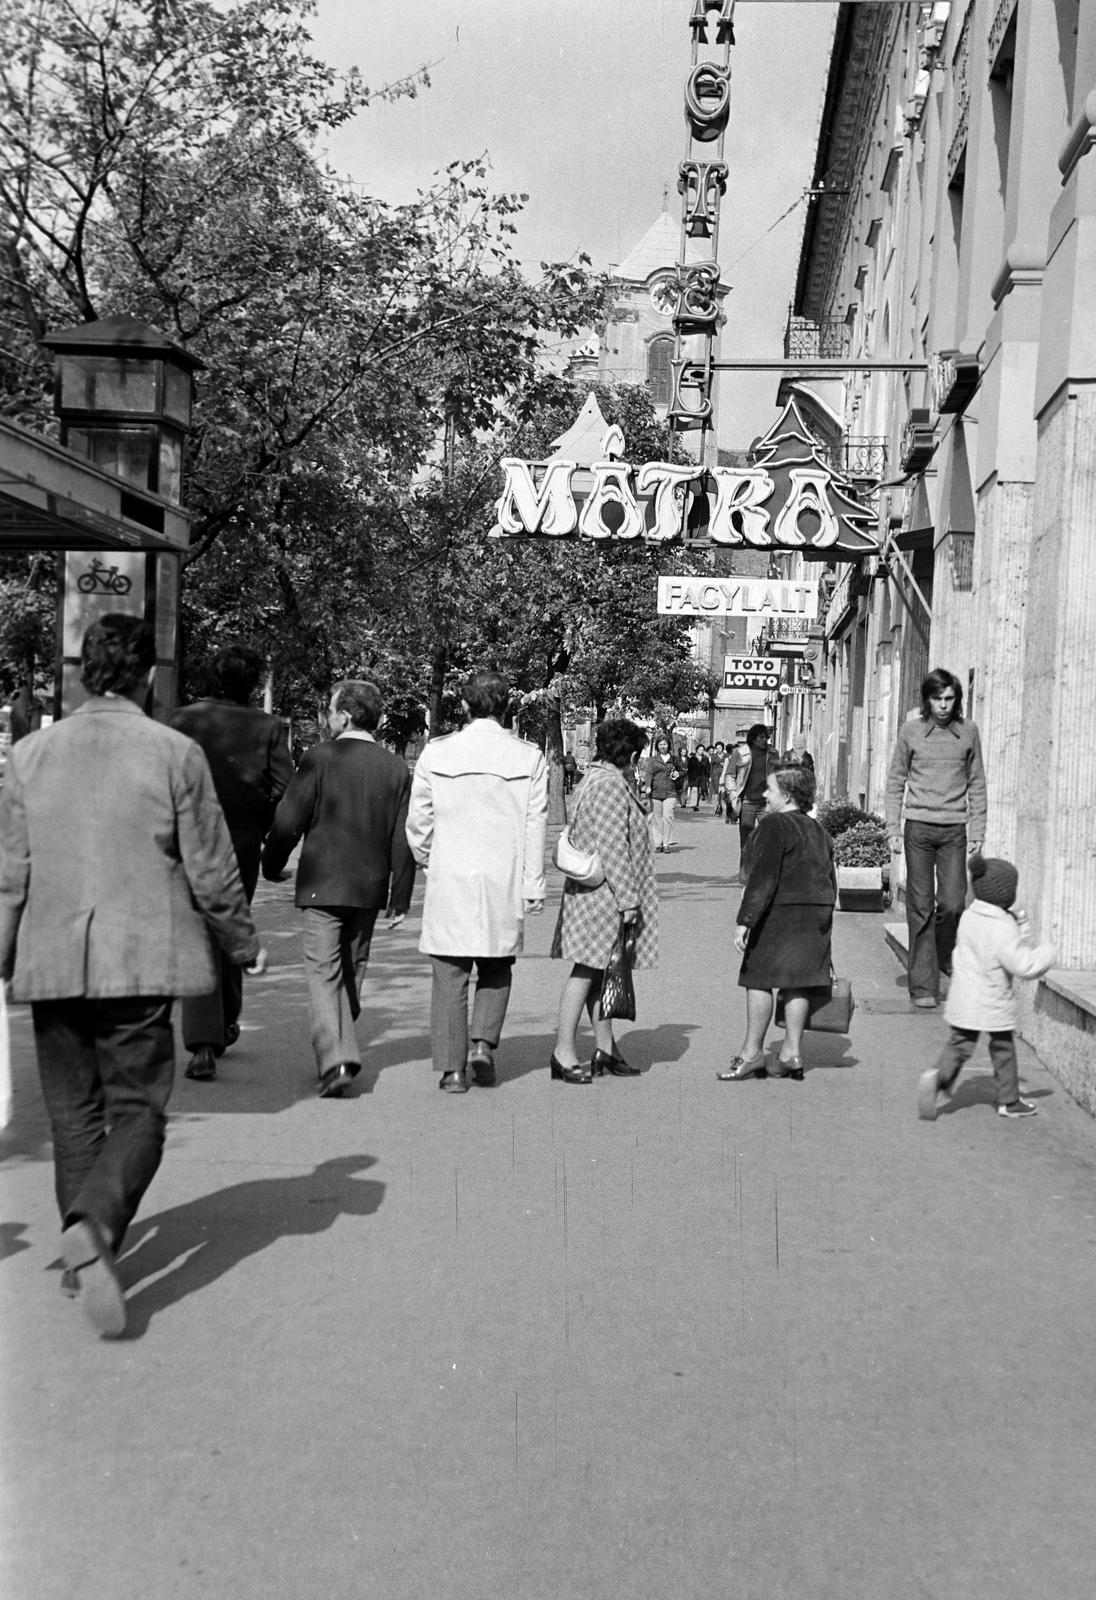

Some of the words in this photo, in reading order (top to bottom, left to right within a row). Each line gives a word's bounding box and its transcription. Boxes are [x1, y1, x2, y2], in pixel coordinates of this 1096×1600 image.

[497, 426, 840, 548] MÁTRA
[665, 584, 811, 613] FAGYLALT
[732, 659, 774, 671] TOTO
[726, 674, 778, 688] LOTTO
